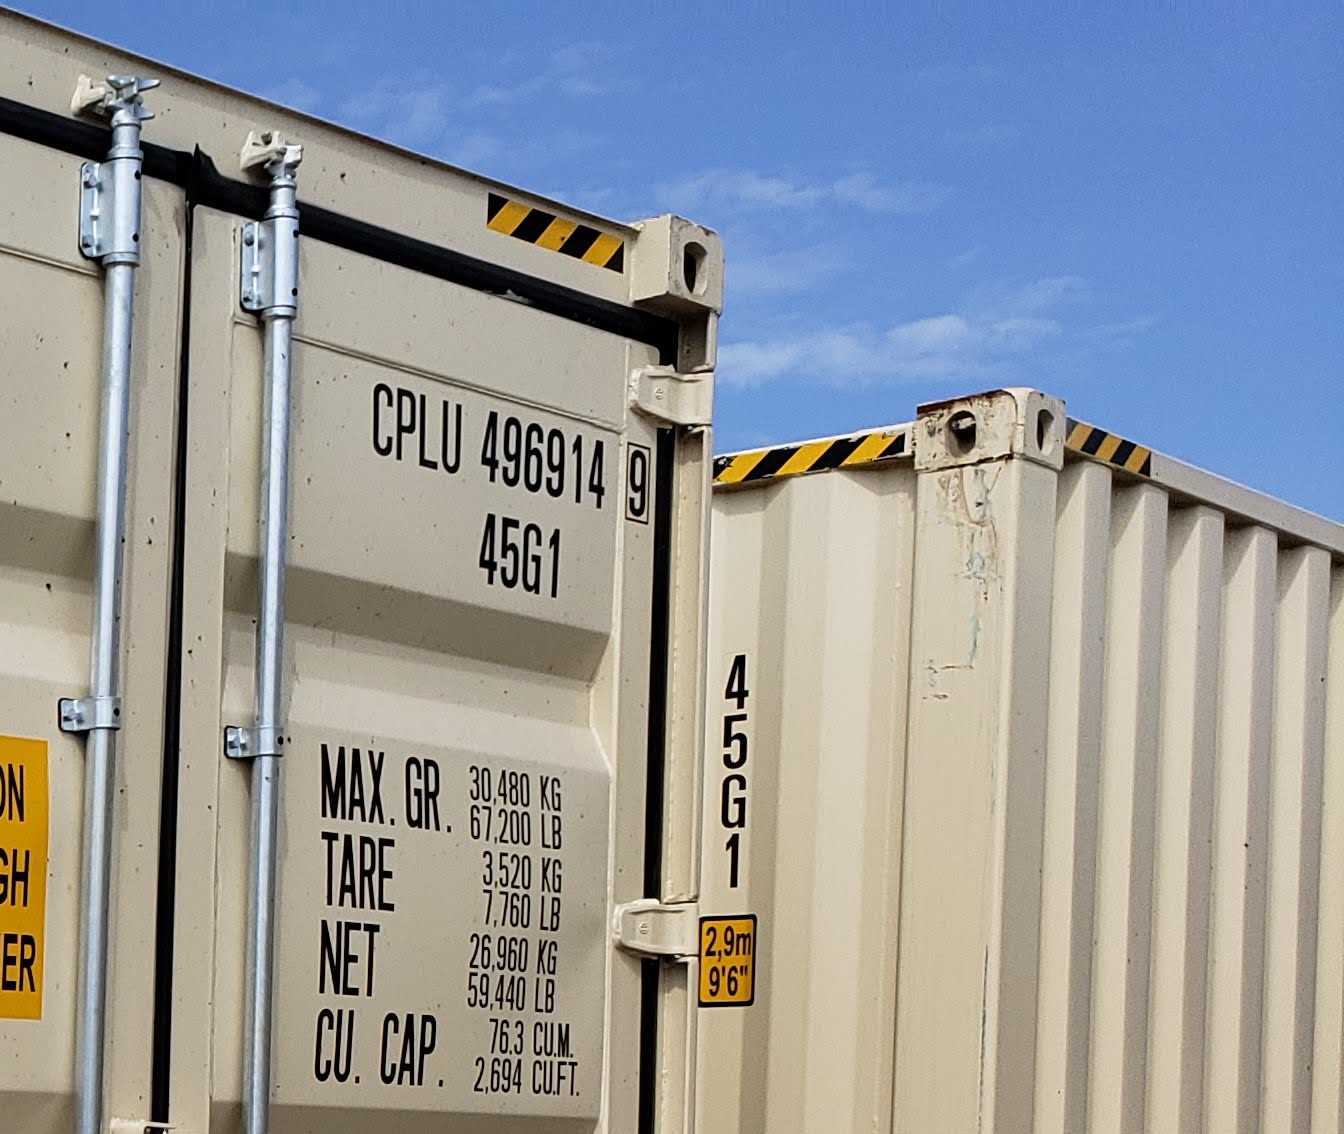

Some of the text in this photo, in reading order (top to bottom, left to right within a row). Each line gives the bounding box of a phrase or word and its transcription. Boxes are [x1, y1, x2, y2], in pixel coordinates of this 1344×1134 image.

[373, 383, 648, 518] CPLU 496914 9
[479, 513, 560, 599] 45G1
[320, 743, 562, 834] MAX. GR. 30,480 KG
[721, 654, 750, 888] 45G1
[470, 805, 562, 850] 67,200 LB
[321, 831, 562, 912] TARE 3,520 KG
[483, 889, 561, 932] 7,760 LB
[319, 919, 557, 997] NET 26,960 KG
[705, 924, 751, 964] 2,9m
[468, 971, 556, 1014] 59,440 LB
[314, 1008, 574, 1088] CU. CAP. 76.3 CU.M.
[473, 1056, 580, 1097] 2,694 CU.FT.
